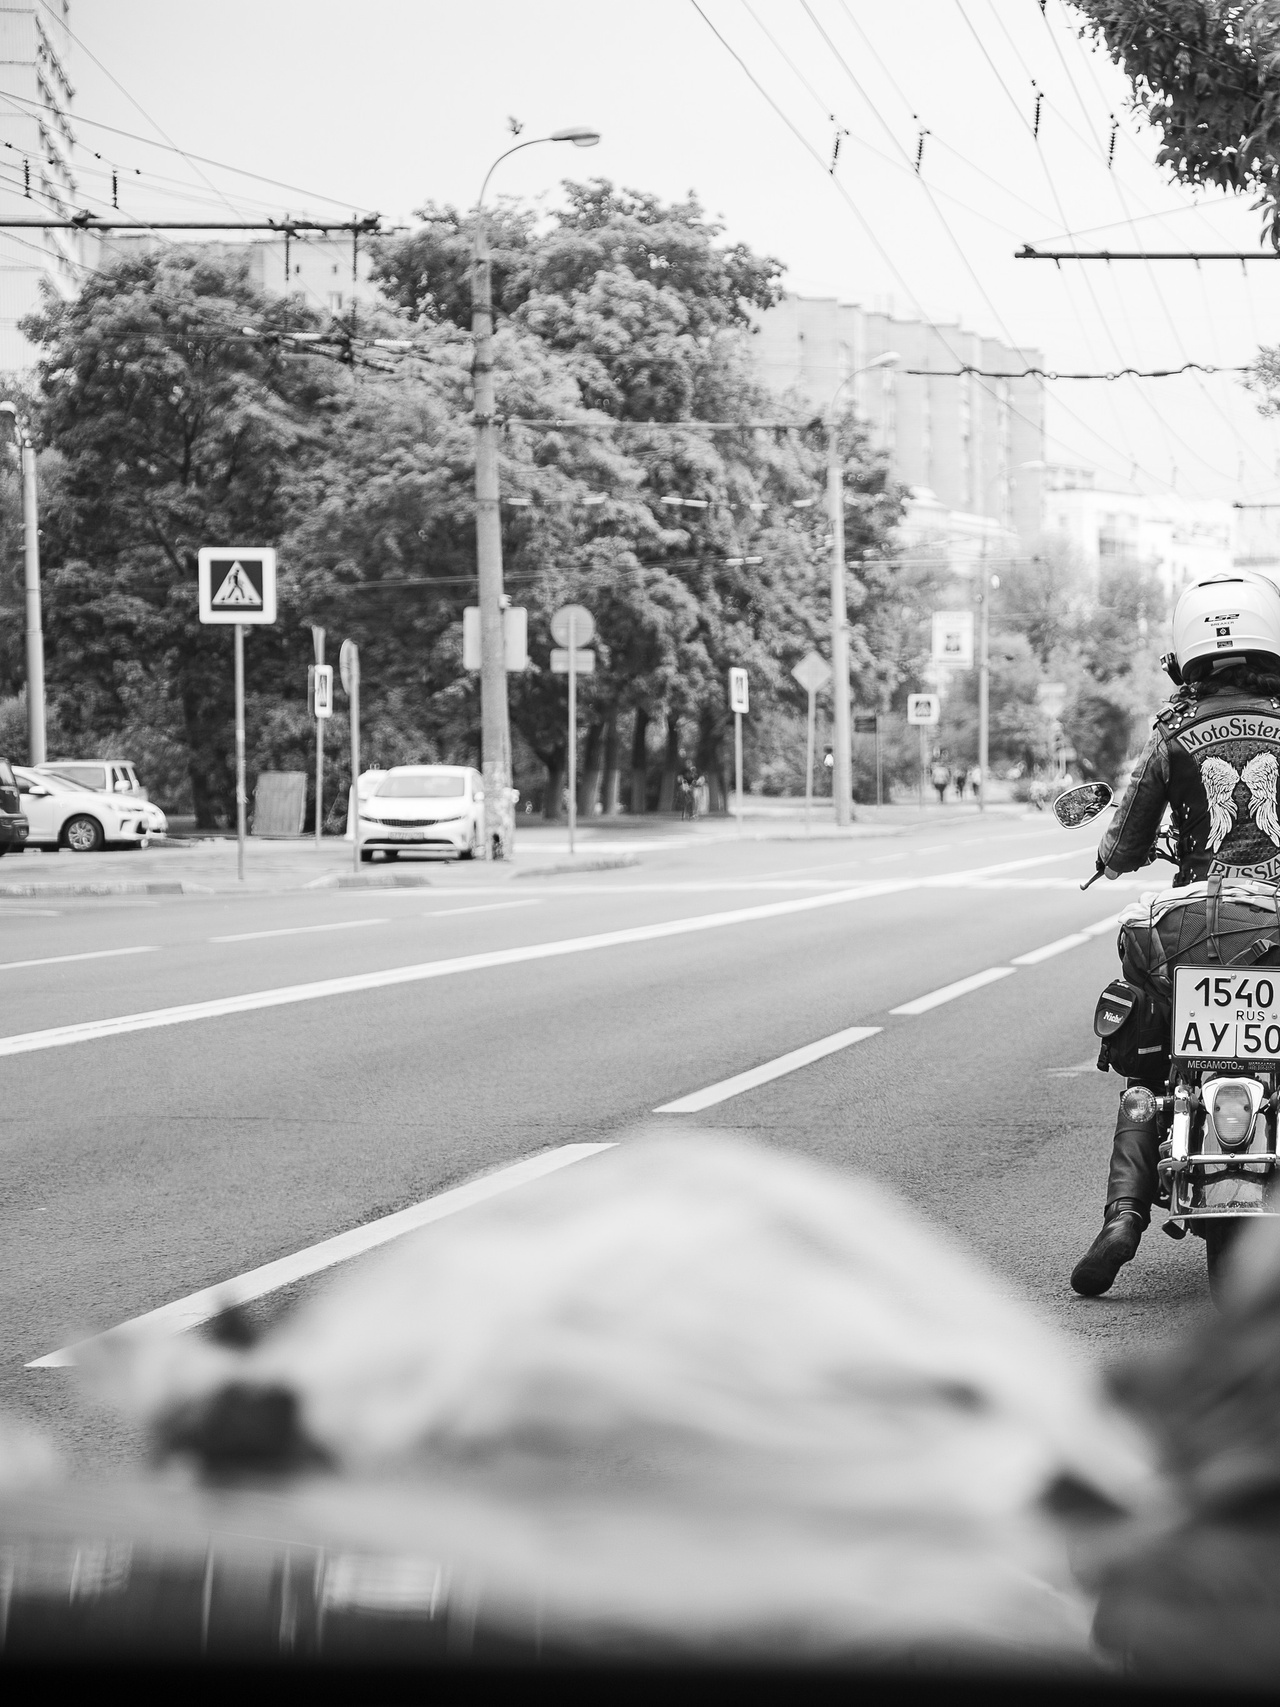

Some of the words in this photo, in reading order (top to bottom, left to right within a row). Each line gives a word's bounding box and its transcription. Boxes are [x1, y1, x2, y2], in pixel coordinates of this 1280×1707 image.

[1204, 613, 1240, 623] LS2
[1194, 977, 1275, 1009] 1540
[1236, 1010, 1265, 1021] RUS
